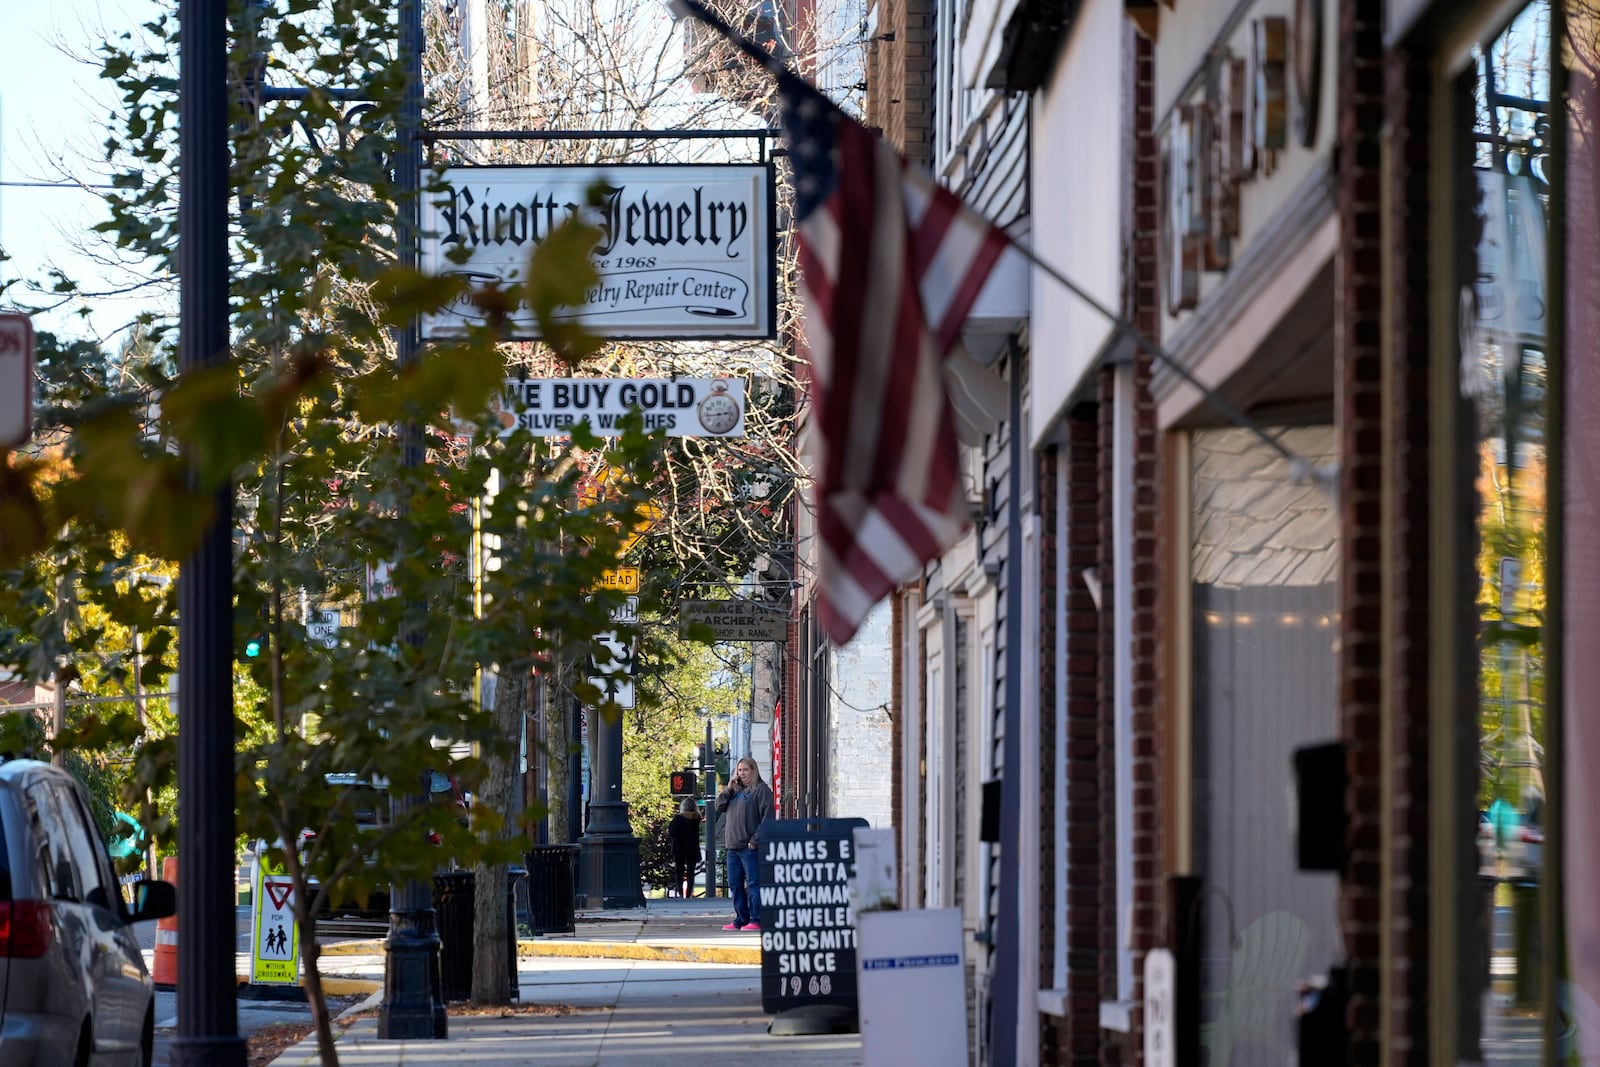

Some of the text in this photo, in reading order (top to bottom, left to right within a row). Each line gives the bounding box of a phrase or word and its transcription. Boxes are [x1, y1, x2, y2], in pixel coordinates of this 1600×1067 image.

[592, 185, 747, 258] Jewelry
[616, 256, 656, 268] 1968
[625, 277, 679, 304] Repair
[682, 277, 736, 300] Center
[553, 384, 612, 408] BUY
[619, 383, 694, 409] GOLD
[518, 413, 574, 429] SILVER
[598, 414, 676, 429] WHES
[595, 575, 633, 585] AHEAD
[703, 616, 764, 626] ARCHERY
[314, 626, 333, 635] ONE
[738, 629, 744, 637] &
[765, 840, 850, 861] JAMES E
[774, 862, 847, 883] RICOTTA
[779, 952, 836, 973] SINCE
[257, 969, 291, 977] CROSSWALK
[780, 974, 832, 997] 1968
